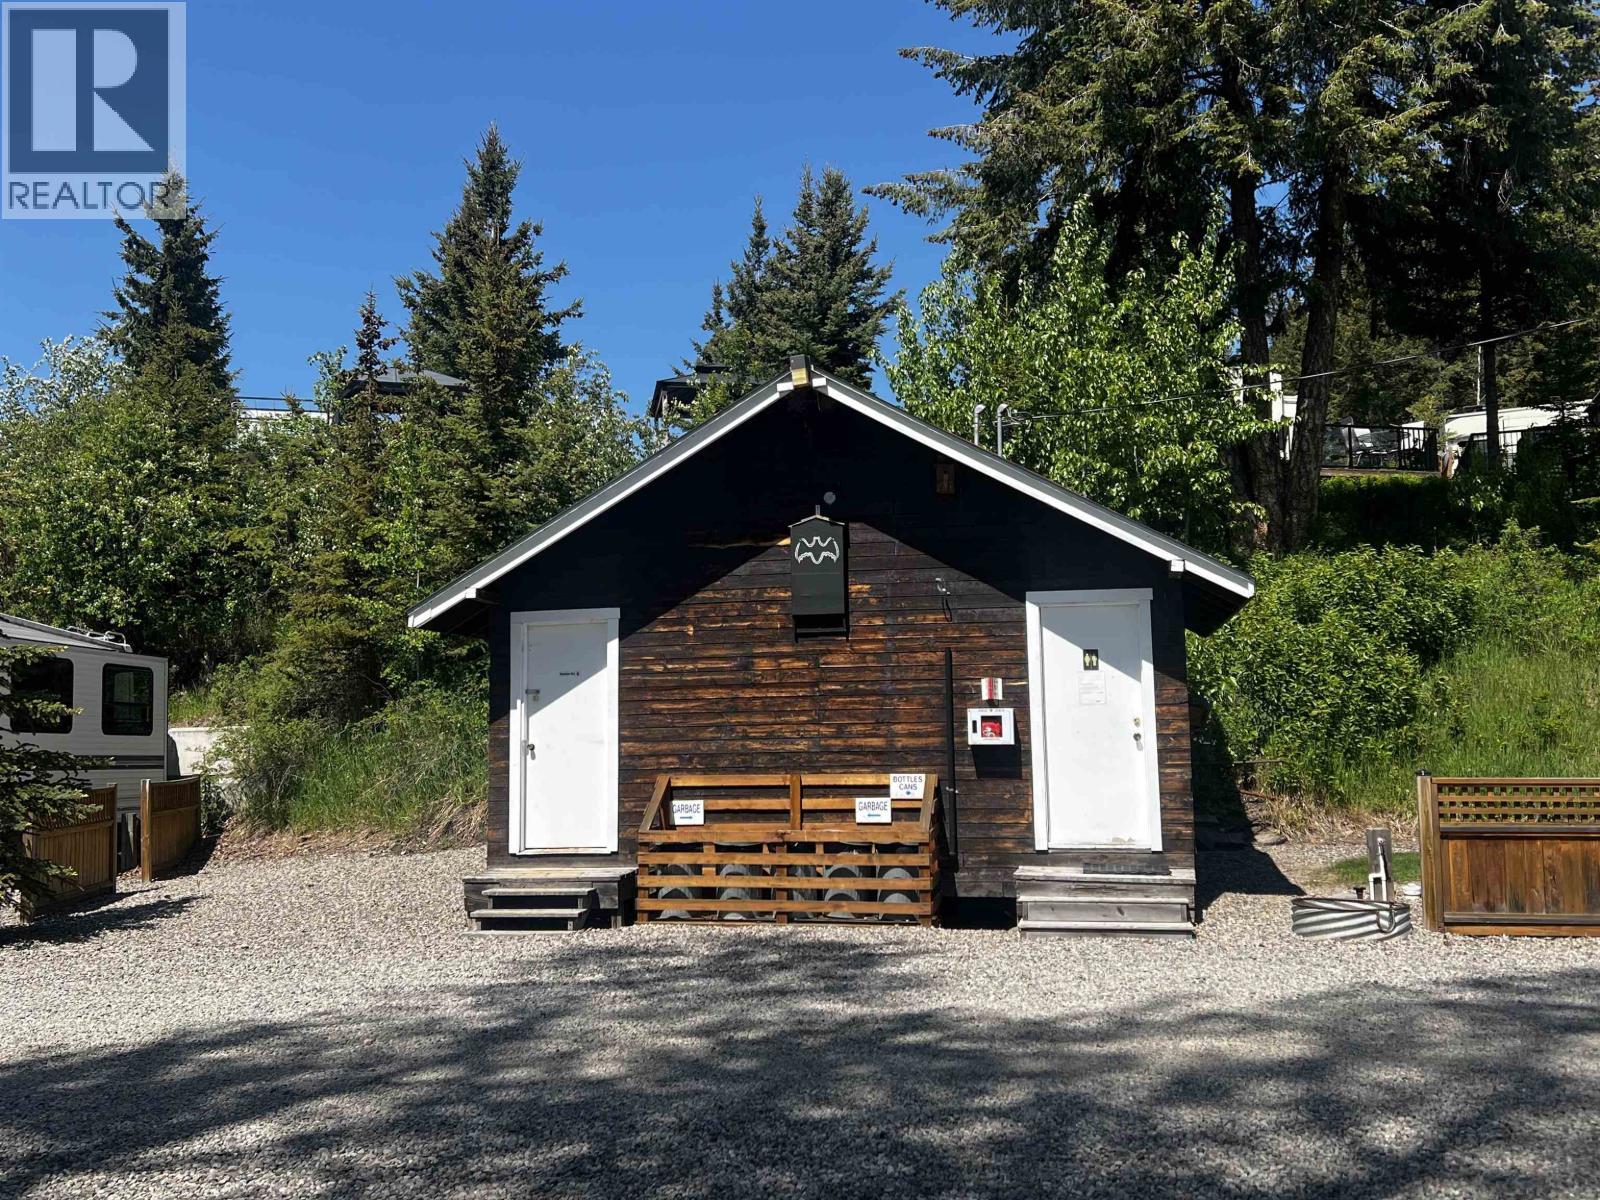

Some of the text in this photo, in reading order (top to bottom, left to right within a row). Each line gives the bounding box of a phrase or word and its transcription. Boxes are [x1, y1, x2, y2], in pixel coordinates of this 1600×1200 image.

[892, 775, 923, 783] BOTTLES
[898, 783, 918, 791] CANS
[671, 803, 701, 814] GARBAGE
[858, 801, 888, 811] GARBAGE
